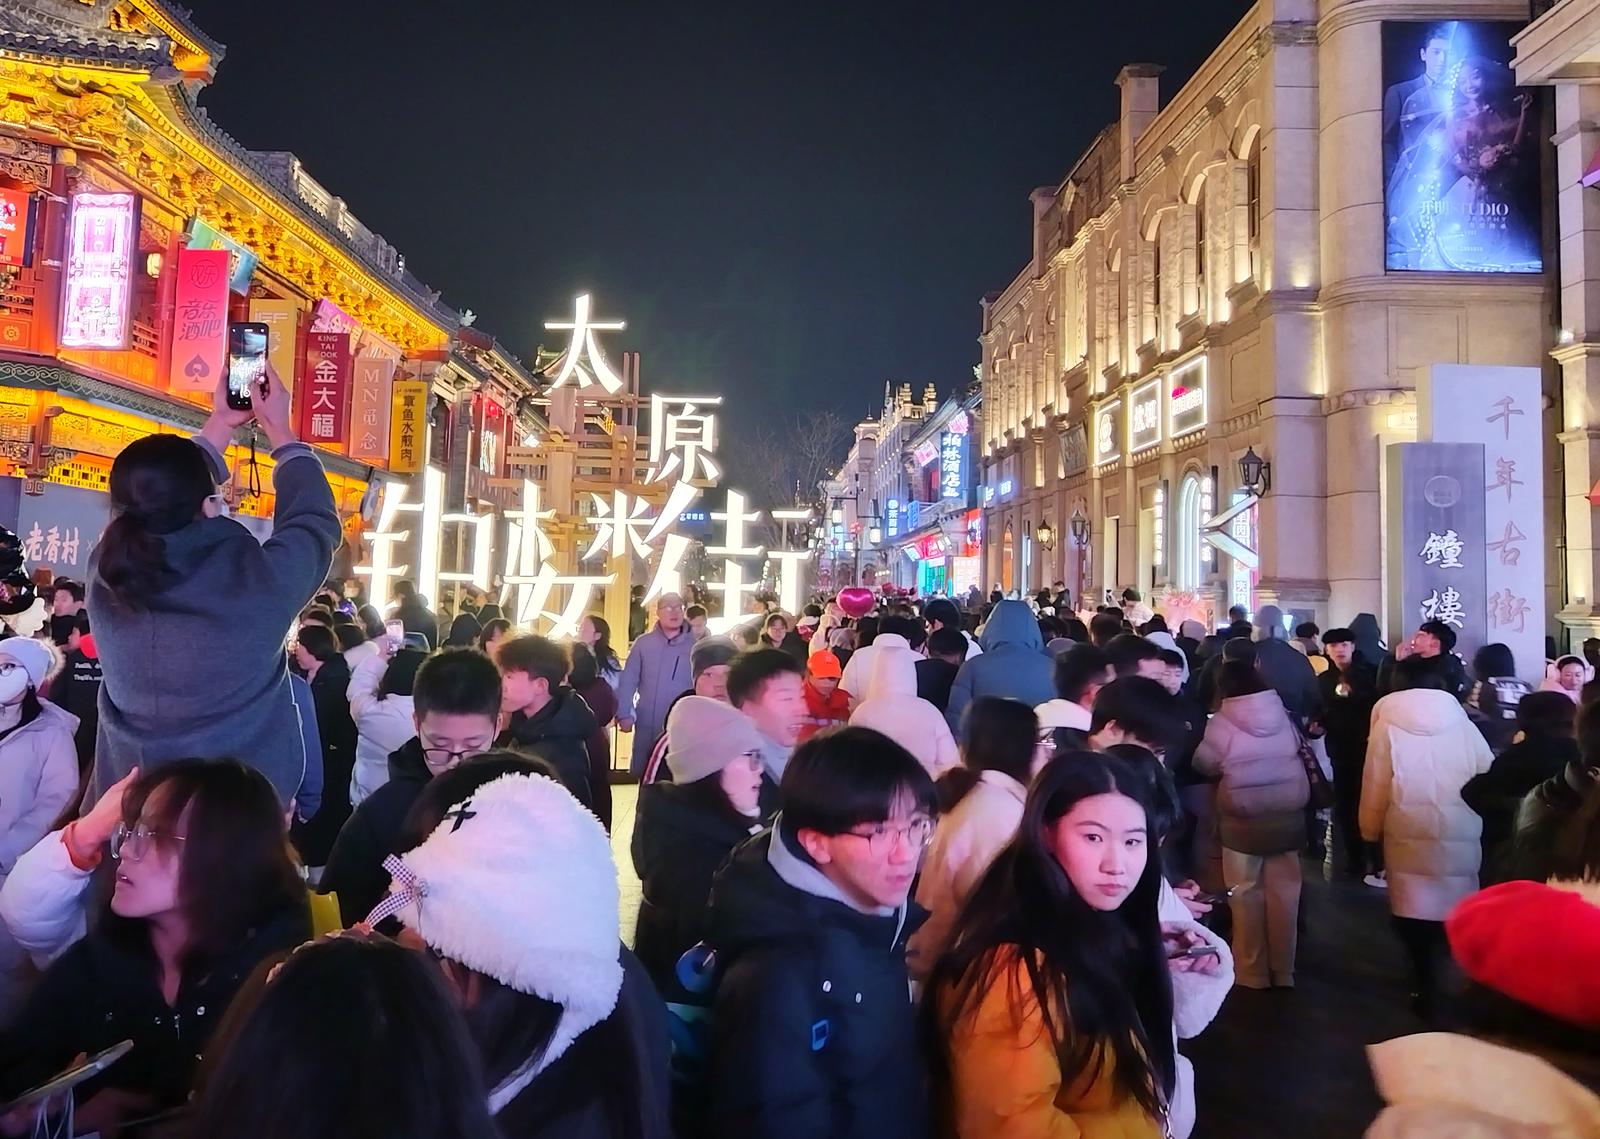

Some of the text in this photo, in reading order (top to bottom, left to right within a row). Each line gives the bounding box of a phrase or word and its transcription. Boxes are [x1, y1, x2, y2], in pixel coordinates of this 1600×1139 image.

[179, 319, 223, 341] 酒吧
[311, 360, 338, 438] 金大福
[23, 520, 80, 566] 老香村
[353, 465, 813, 637] 钟楼街
[1486, 395, 1531, 633] 千年古街
[1419, 529, 1467, 667] 鐘樓
